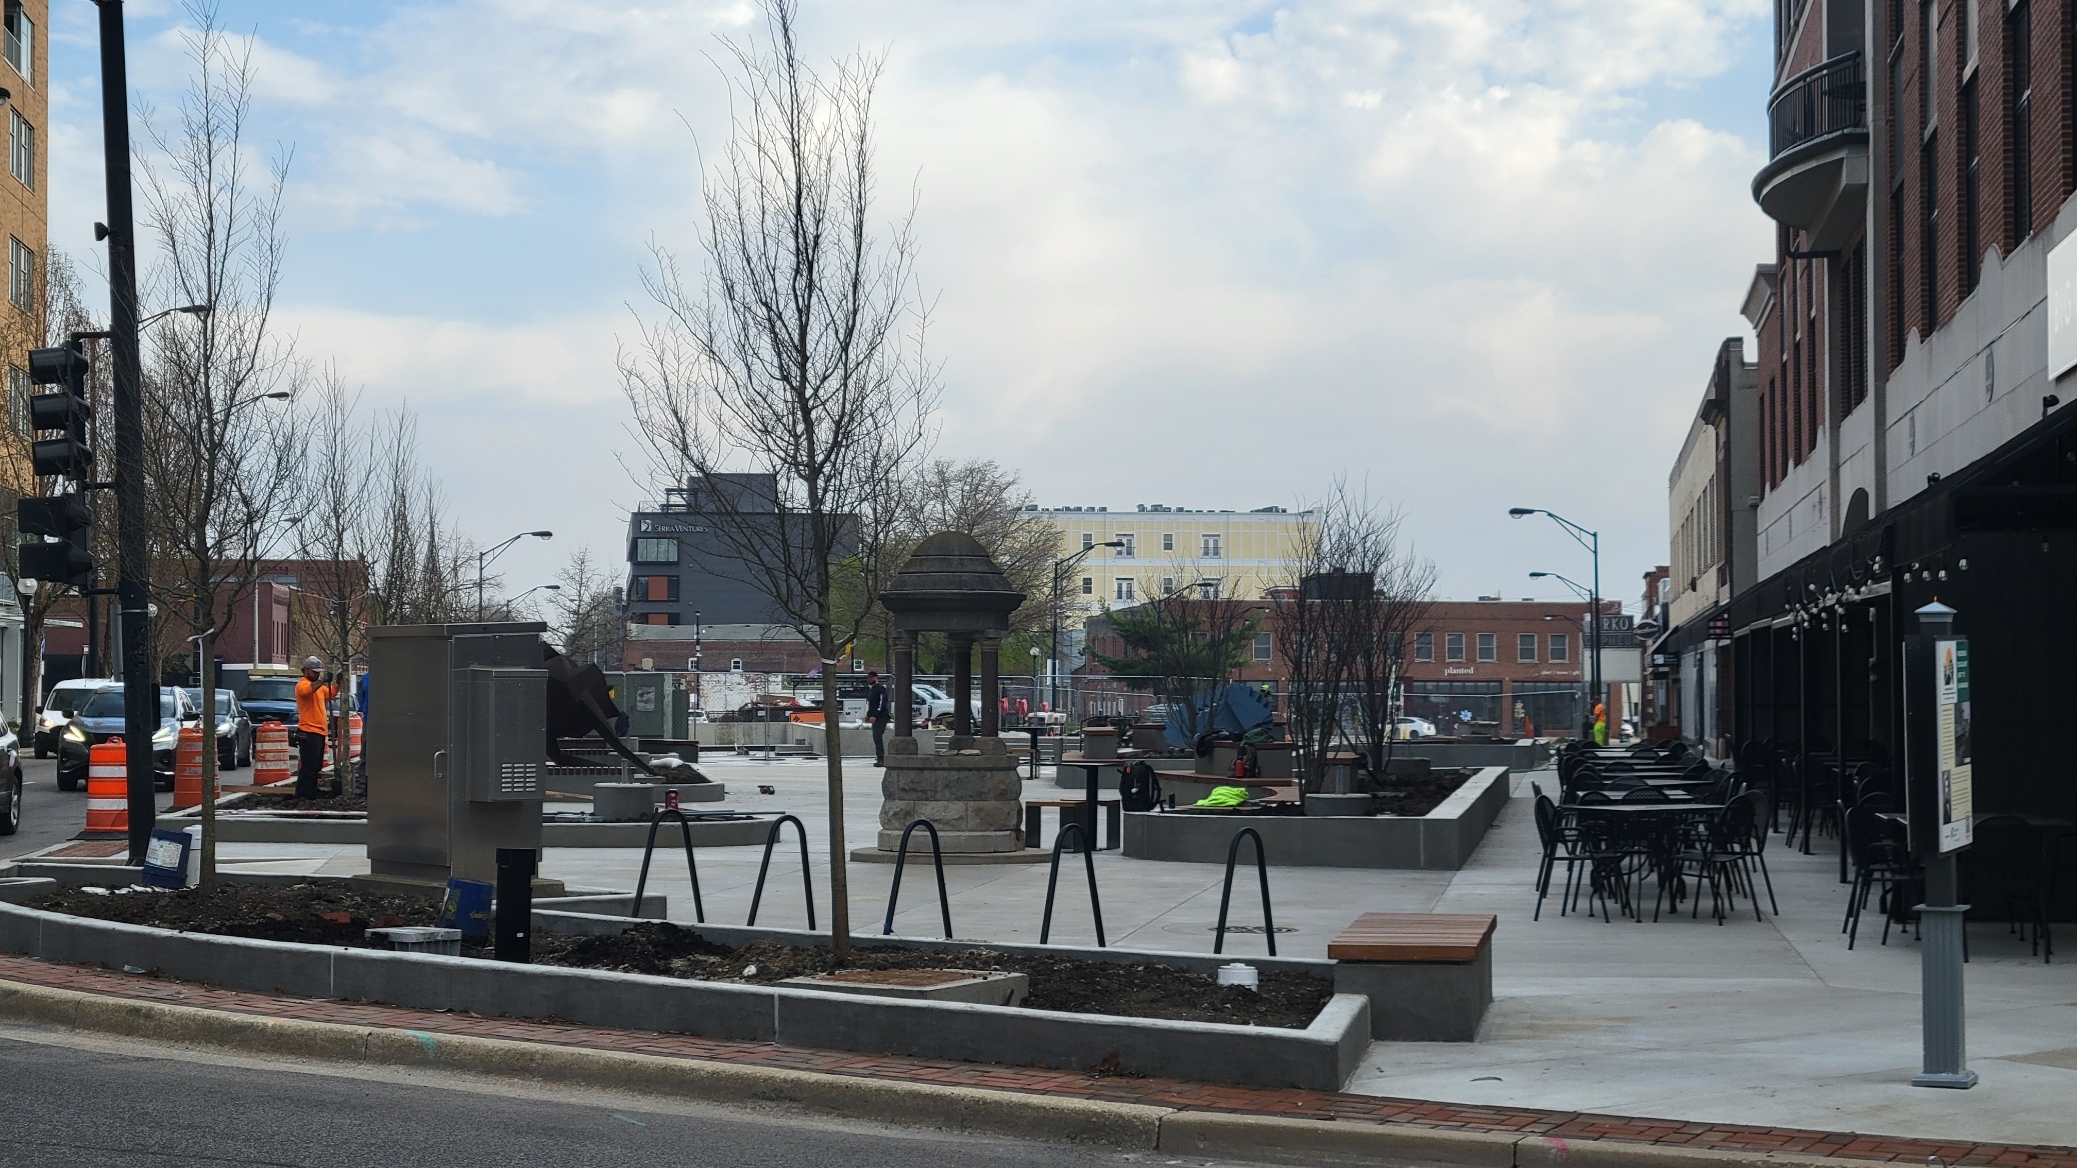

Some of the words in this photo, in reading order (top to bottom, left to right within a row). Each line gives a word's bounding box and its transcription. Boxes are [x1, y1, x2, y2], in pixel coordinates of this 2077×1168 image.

[1603, 617, 1629, 631] RKO
[1585, 635, 1641, 646] OPHEU
[1444, 666, 1474, 676] planted
